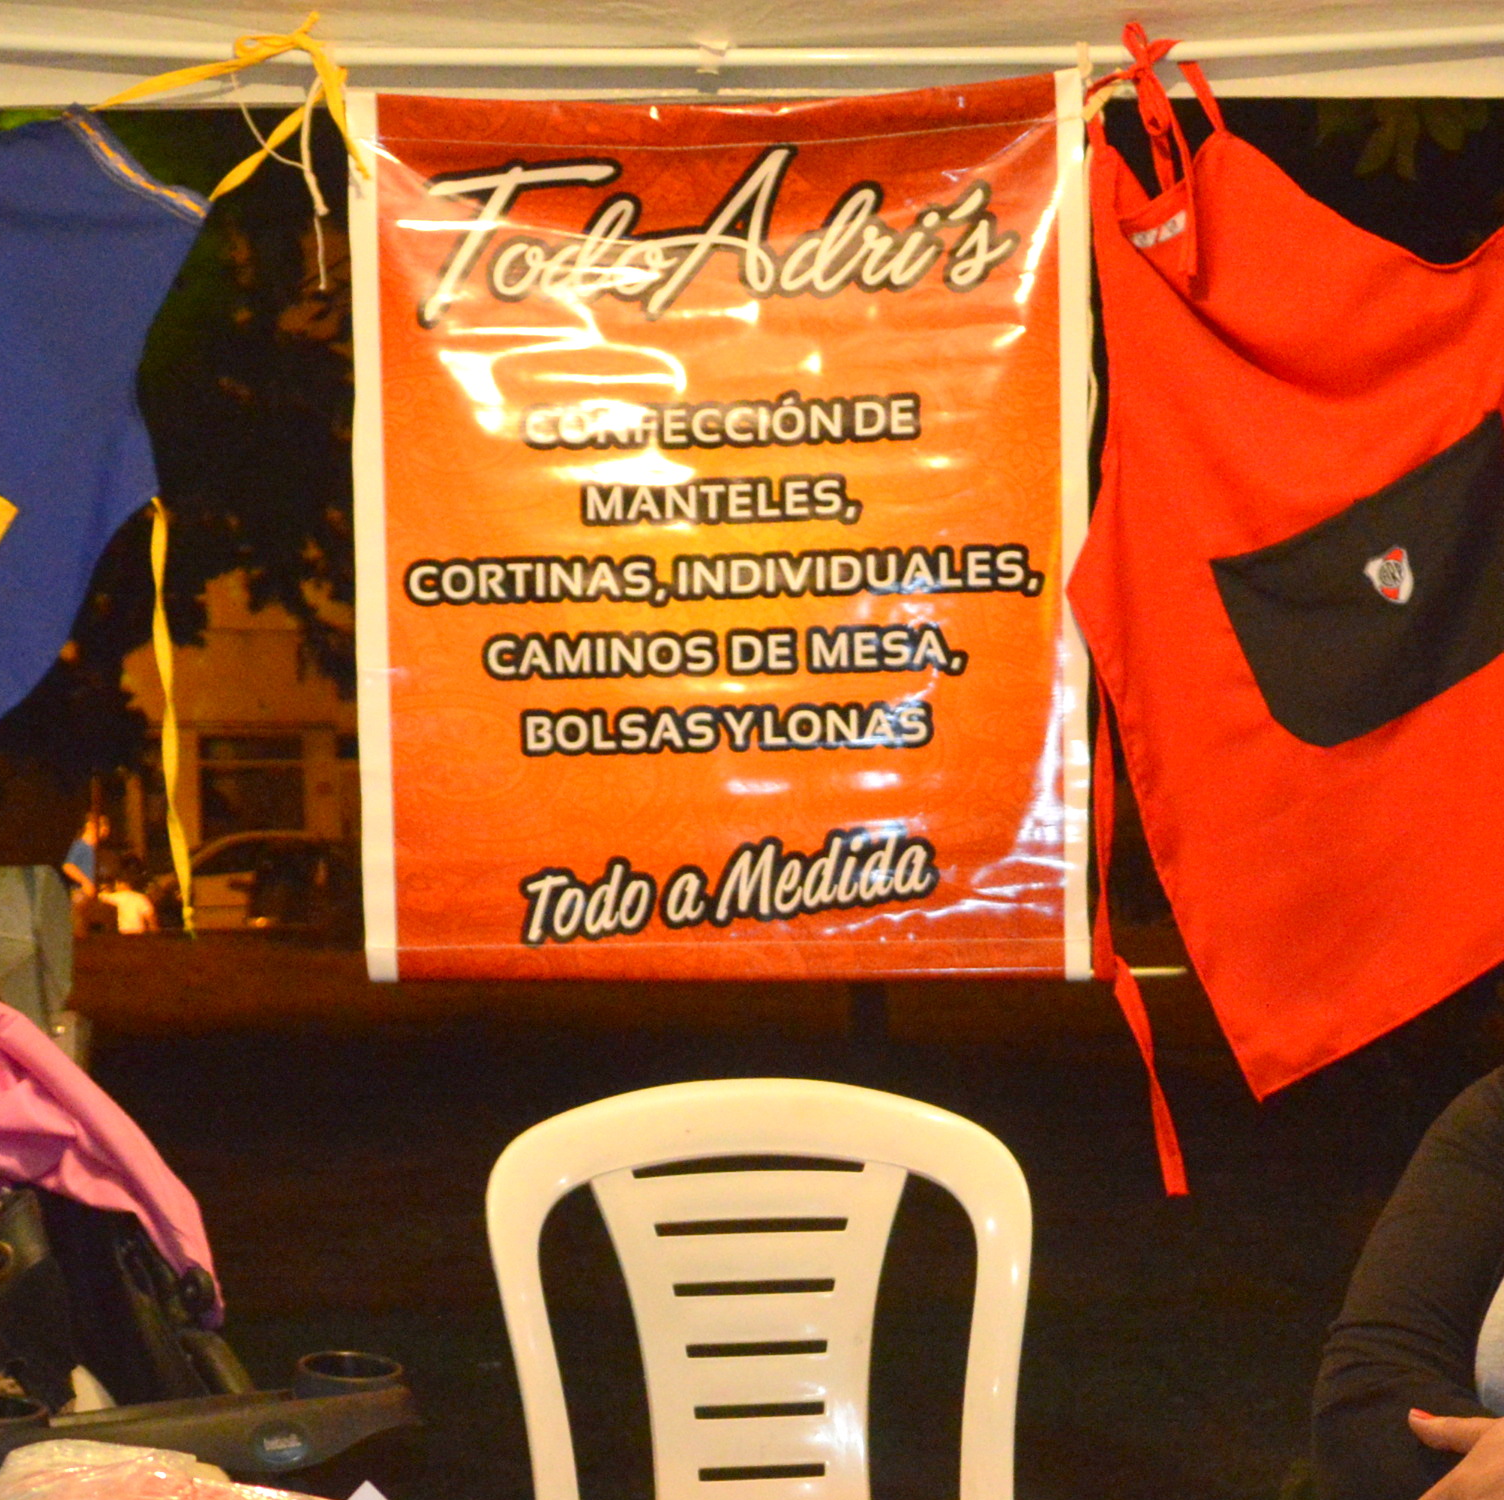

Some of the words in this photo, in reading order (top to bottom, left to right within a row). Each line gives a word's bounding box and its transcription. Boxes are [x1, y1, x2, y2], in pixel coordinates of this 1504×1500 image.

[523, 397, 843, 447] CONFECCIÓN
[853, 397, 918, 438] DE
[585, 478, 859, 521] MANTELES,
[407, 560, 667, 605] CORTINAS,
[676, 549, 1041, 598] INDIVIDUALES,
[486, 635, 715, 677] CAMINOS
[731, 632, 796, 672] DE
[811, 629, 964, 671] MESA,
[524, 712, 715, 753] BOLSAS
[715, 710, 756, 748] Y
[763, 705, 930, 746] LONAS
[526, 863, 651, 943] Todo
[665, 870, 705, 924] a
[714, 833, 934, 918] Medida
